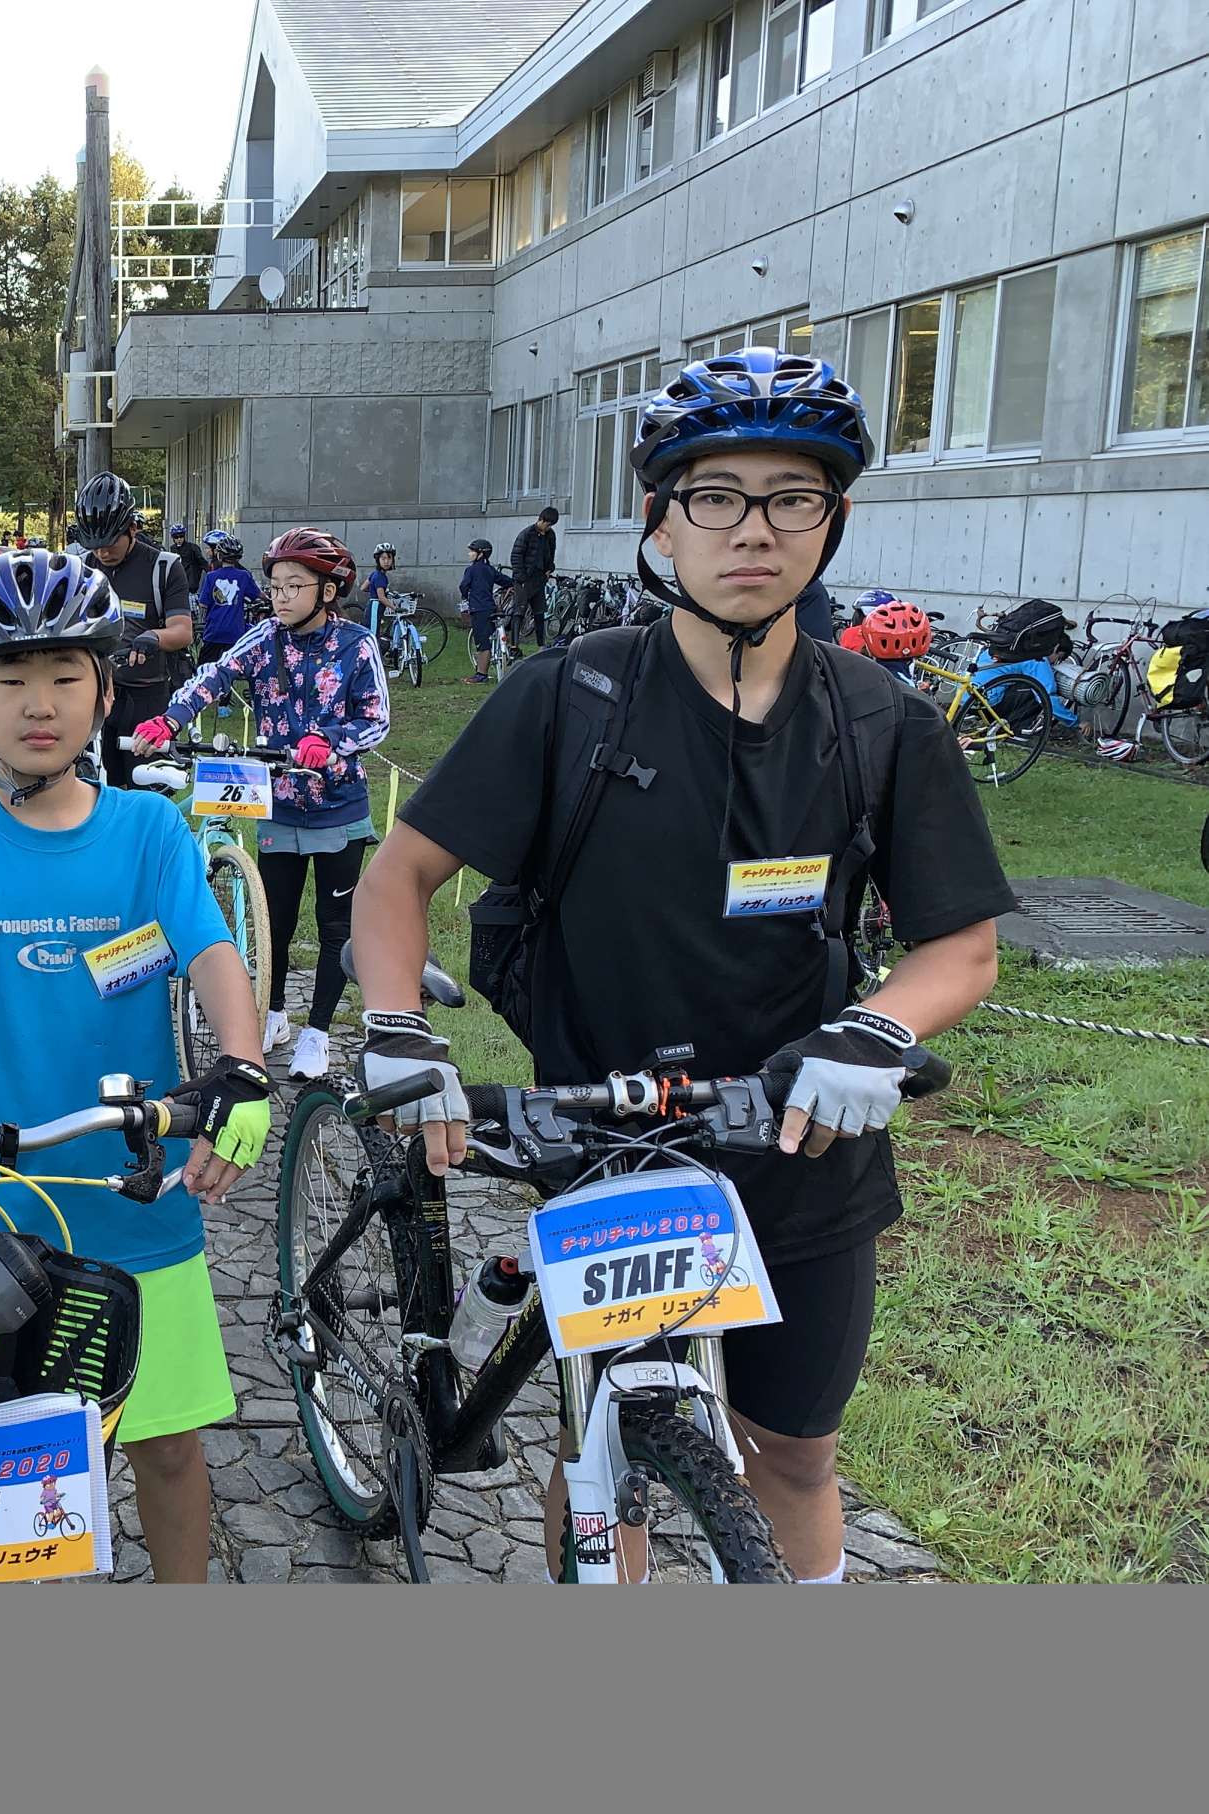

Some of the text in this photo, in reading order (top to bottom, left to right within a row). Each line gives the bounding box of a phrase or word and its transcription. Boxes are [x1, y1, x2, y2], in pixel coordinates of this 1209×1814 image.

[219, 784, 245, 802] 26
[741, 863, 822, 878] チャリチャレ 2020
[739, 898, 772, 910] ナガイ
[55, 918, 67, 933] &
[69, 915, 121, 932] Fastest
[95, 940, 135, 963] チャリチャレ
[135, 928, 157, 945] 2020
[105, 970, 138, 992] オオツカ
[560, 1213, 720, 1254] チャリチャレ2020
[582, 1247, 695, 1306] STAFF
[602, 1305, 647, 1328] ナガイ
[575, 1516, 606, 1535] ROCK
